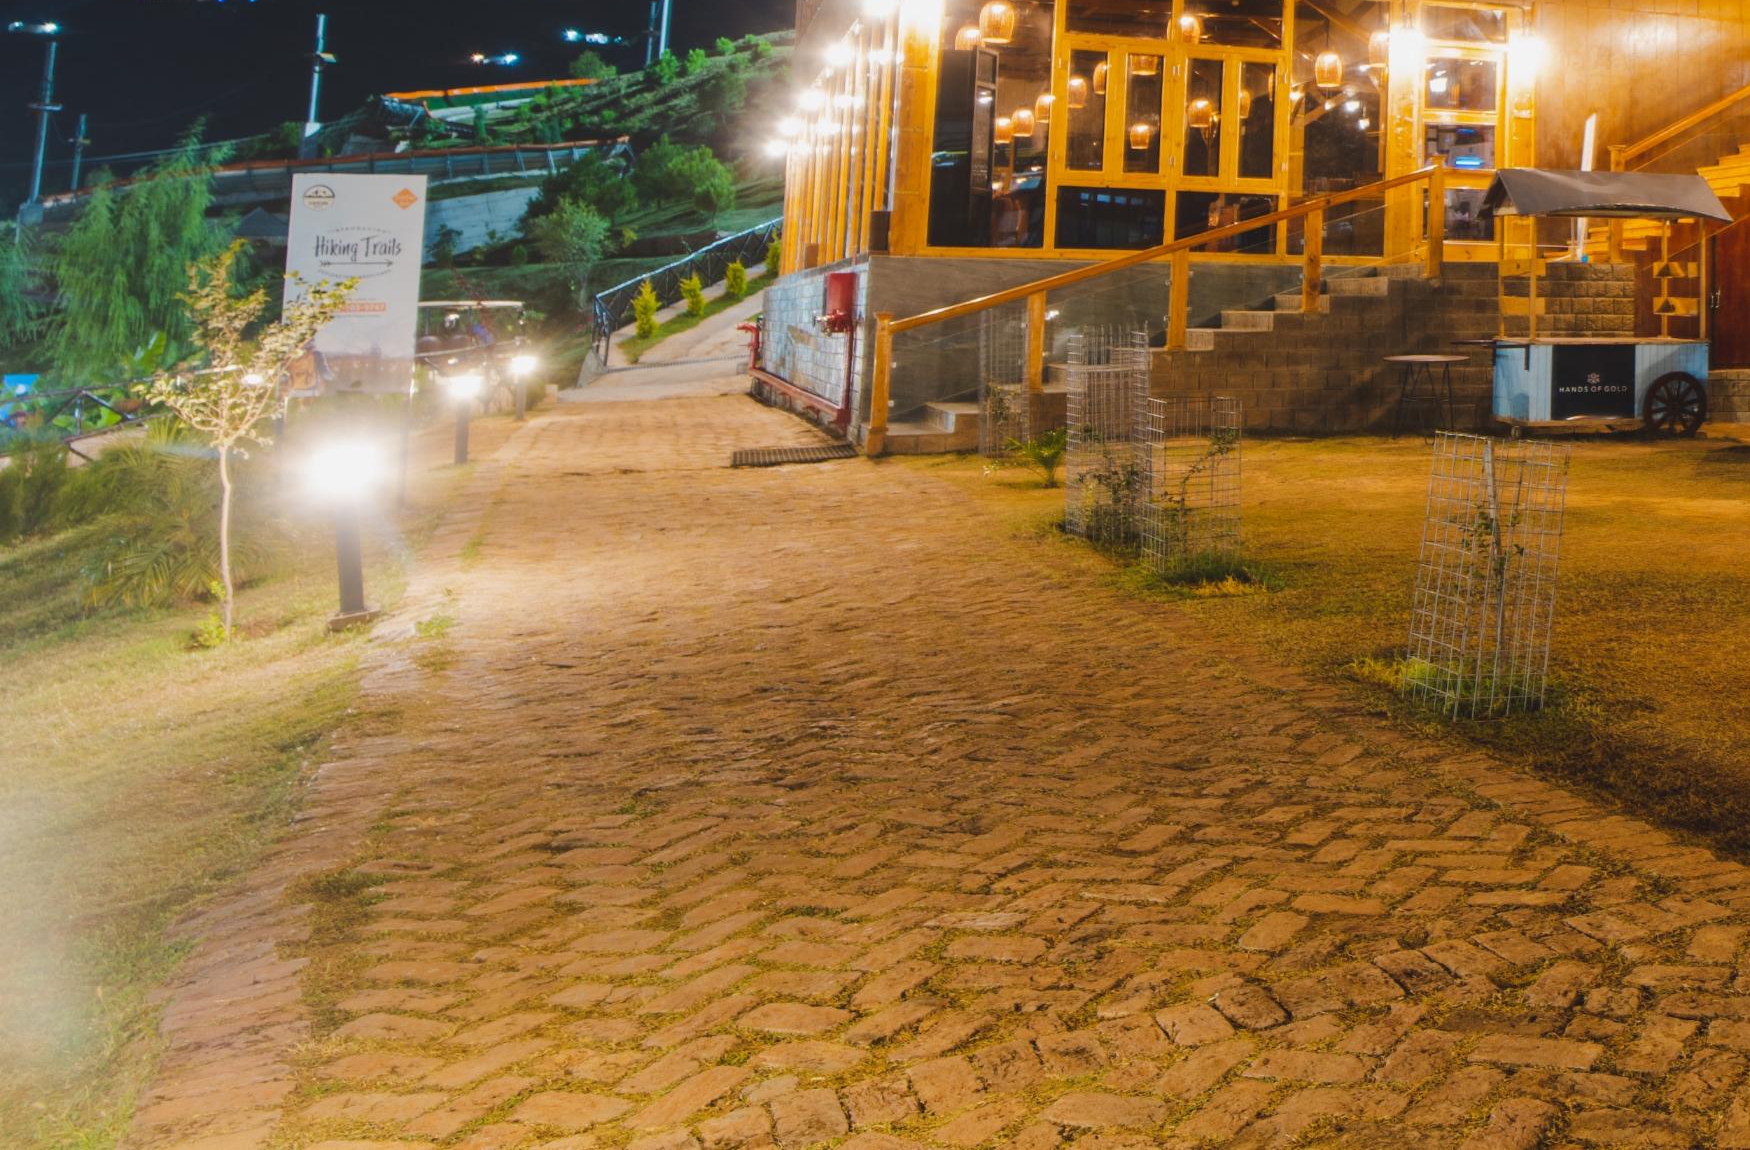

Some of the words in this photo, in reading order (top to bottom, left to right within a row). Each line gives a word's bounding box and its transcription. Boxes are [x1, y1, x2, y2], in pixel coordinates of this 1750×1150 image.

[314, 235, 359, 263] Hiking
[360, 234, 402, 258] Trails
[1559, 385, 1589, 393] HANDS
[1590, 385, 1602, 393] OF
[1603, 385, 1628, 393] GOLD
